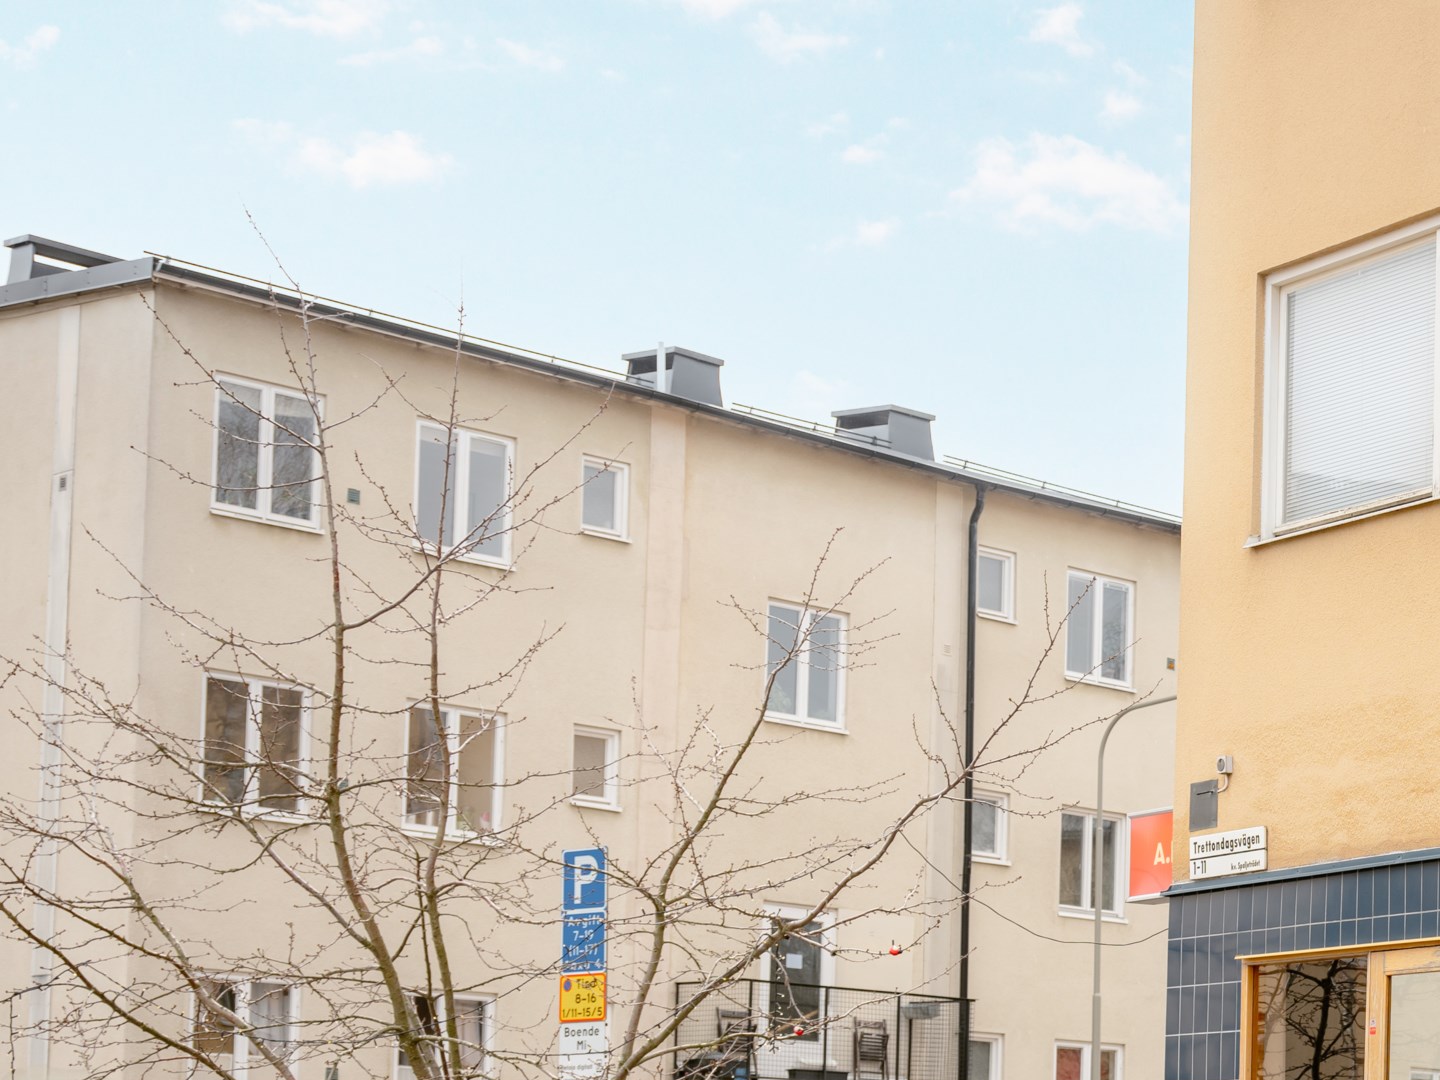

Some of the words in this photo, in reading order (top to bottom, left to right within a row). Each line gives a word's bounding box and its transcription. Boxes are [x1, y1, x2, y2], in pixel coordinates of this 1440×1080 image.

[1193, 834, 1260, 854] Trettondagsvägen
[1153, 841, 1173, 866] A.
[1193, 860, 1207, 875] 1-11
[572, 929, 594, 942] 7-19
[568, 943, 598, 957] (11-17)
[575, 993, 597, 1004] 8-16
[562, 1006, 603, 1018] 1/11-15/5
[564, 1026, 600, 1037] Boende
[576, 1039, 587, 1050] Mi
